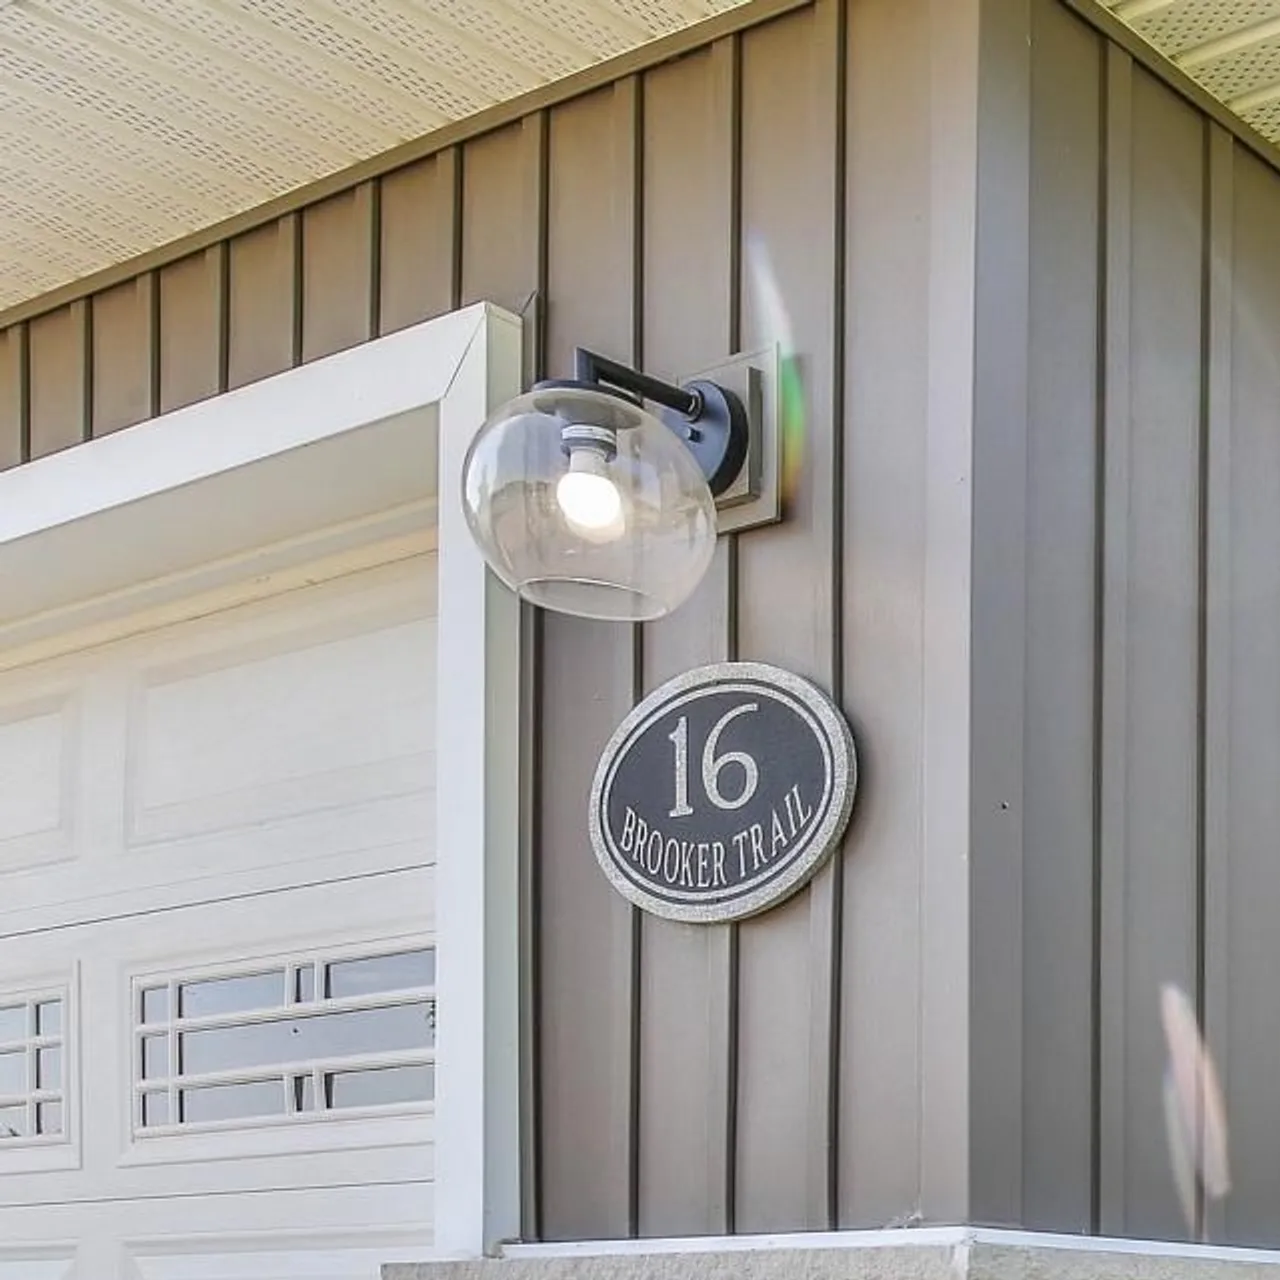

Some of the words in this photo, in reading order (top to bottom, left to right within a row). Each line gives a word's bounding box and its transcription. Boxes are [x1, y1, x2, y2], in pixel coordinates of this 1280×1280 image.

[668, 702, 759, 818] 16
[619, 805, 727, 888] BROOKER
[732, 783, 812, 878] TRAIL
